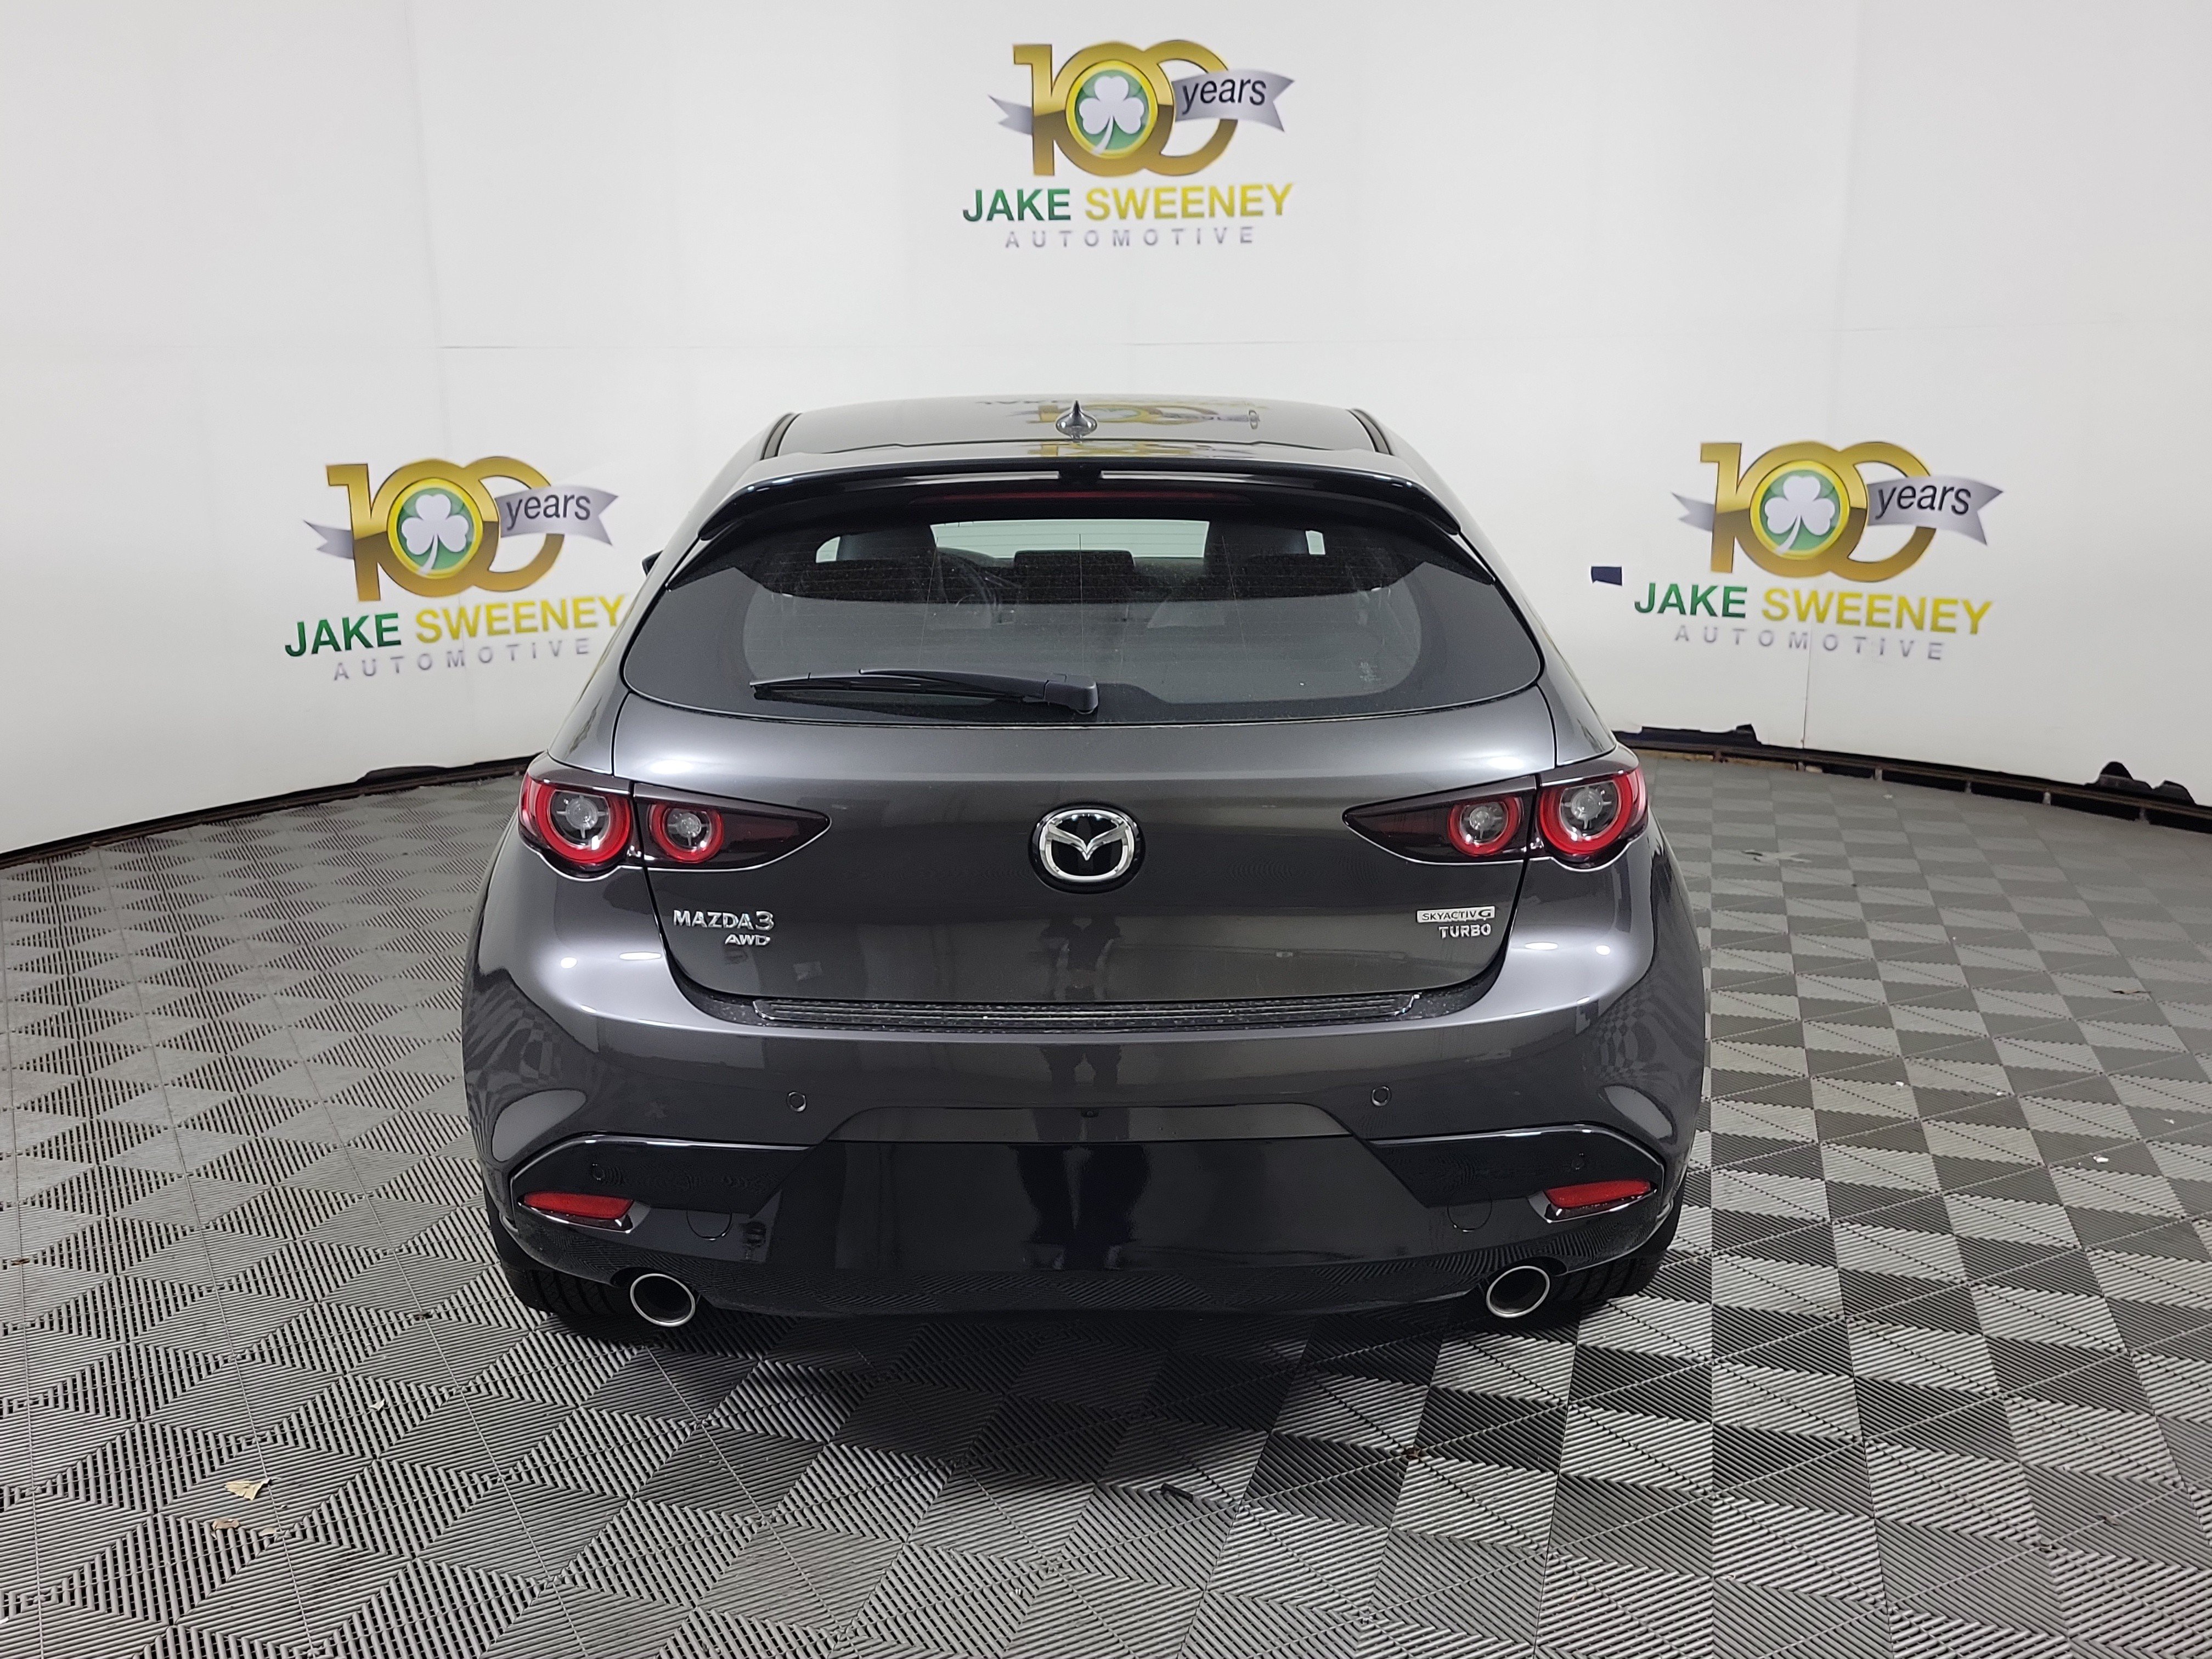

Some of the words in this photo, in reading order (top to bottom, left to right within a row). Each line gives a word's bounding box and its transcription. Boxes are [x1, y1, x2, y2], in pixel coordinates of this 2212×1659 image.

[1181, 78, 1267, 115] years
[963, 188, 1071, 222] JAKE
[1085, 183, 1294, 221] SWEENEY
[1005, 227, 1255, 249] AUTOMOTIVE
[506, 494, 591, 531] years
[1875, 485, 1972, 520] years
[285, 613, 402, 657] JAKE
[415, 595, 625, 644] SWEENEY
[1634, 583, 1747, 619] JAKE
[1762, 588, 1993, 635] SWEENEY
[333, 638, 590, 681] AUTOMOTIVE
[1674, 624, 1944, 660] AUTOMOTIVE
[725, 934, 771, 946] AWD
[1438, 923, 1491, 939] TURBO
